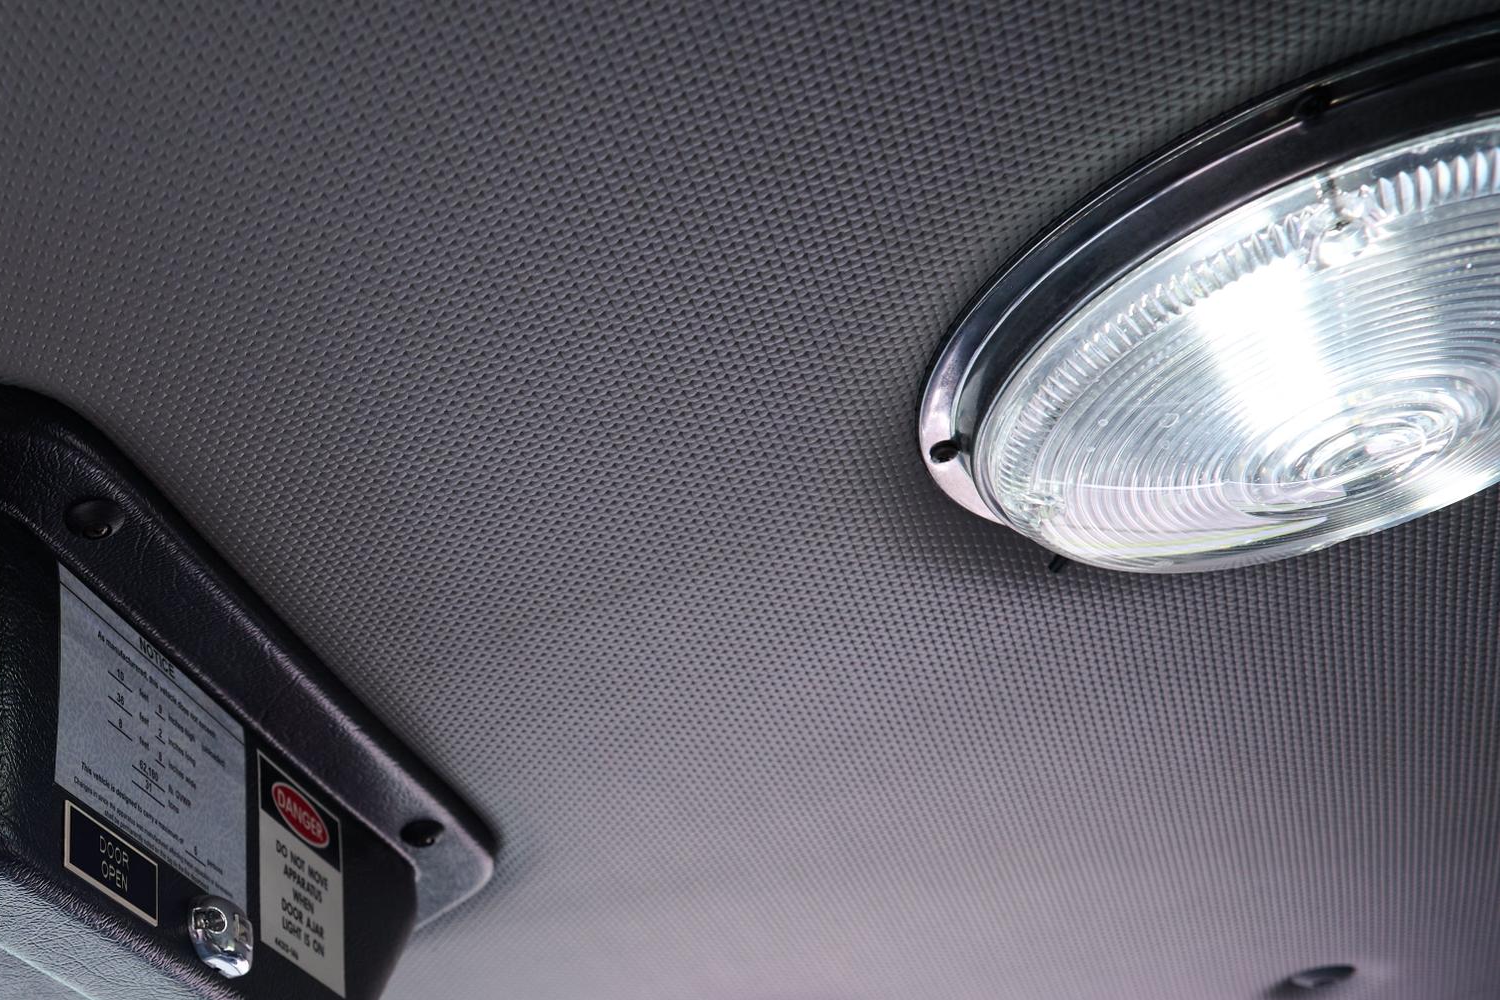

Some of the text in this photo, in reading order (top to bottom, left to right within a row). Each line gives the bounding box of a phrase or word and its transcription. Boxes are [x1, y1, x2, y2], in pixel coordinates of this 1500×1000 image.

[139, 637, 175, 679] NOTICE
[81, 761, 91, 775] This
[93, 770, 109, 788] vehicle
[276, 786, 323, 841] DANGER
[99, 835, 129, 871] DOOR
[275, 839, 328, 890] DO NOT MOVE
[101, 859, 127, 892] OPEN
[281, 897, 303, 923] DOOR
[281, 915, 302, 941] LIGHT
[312, 938, 324, 957] ON
